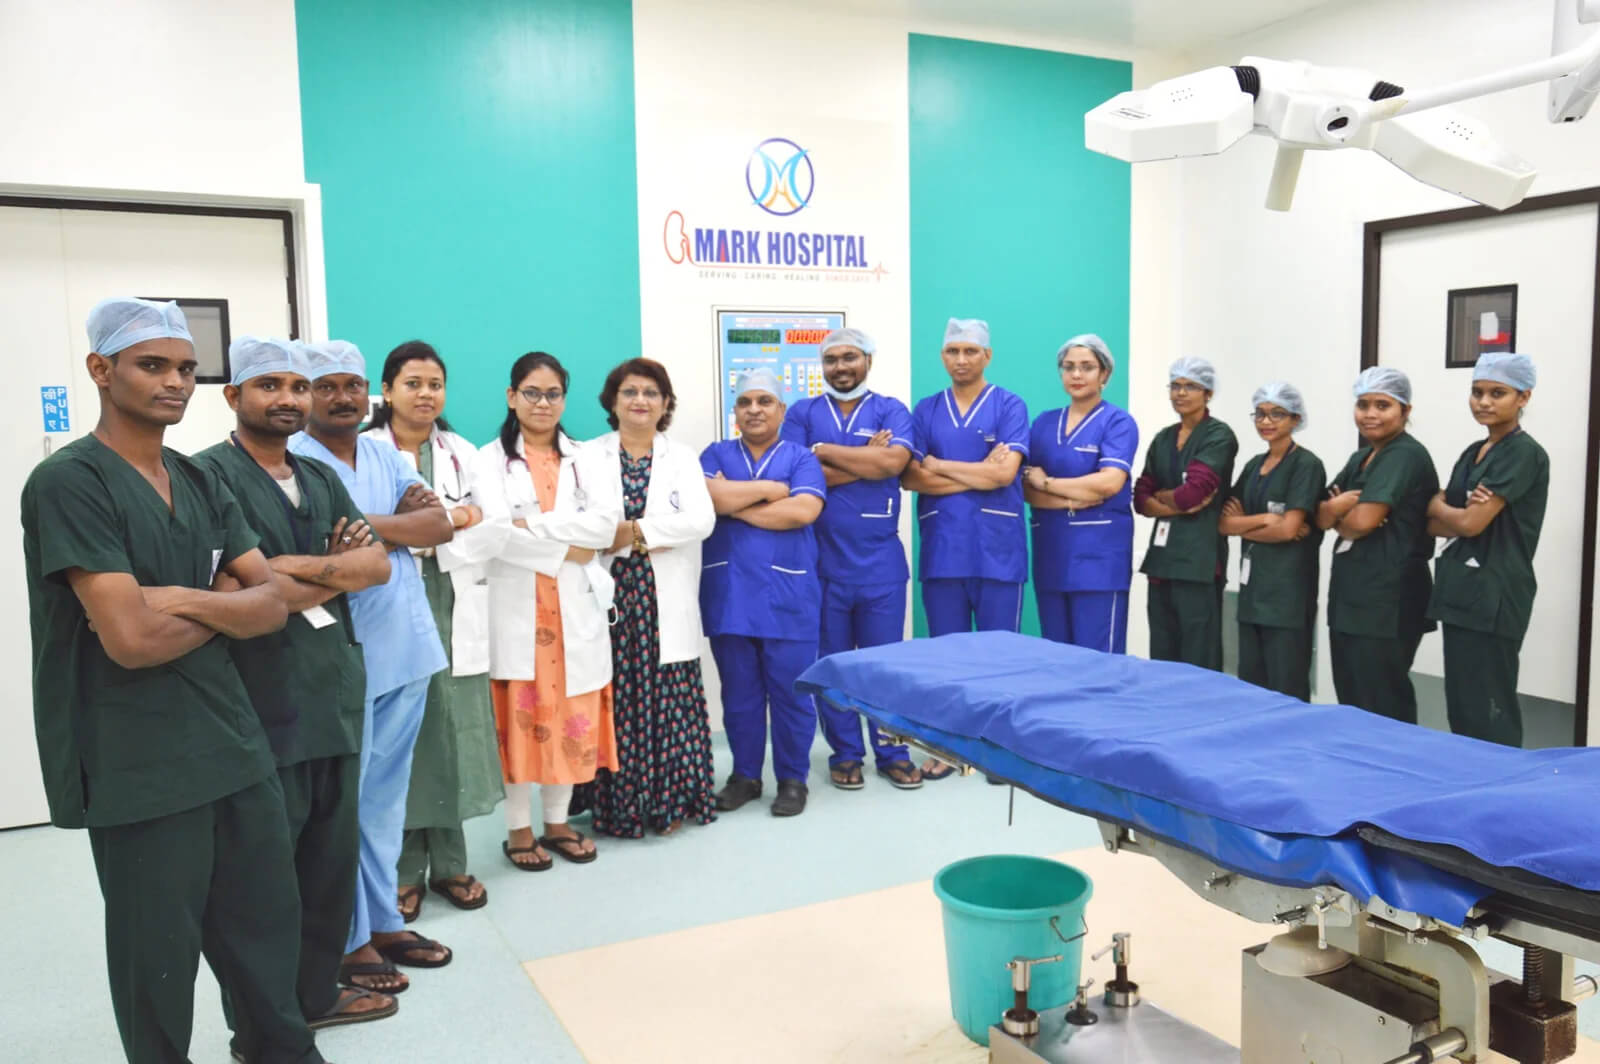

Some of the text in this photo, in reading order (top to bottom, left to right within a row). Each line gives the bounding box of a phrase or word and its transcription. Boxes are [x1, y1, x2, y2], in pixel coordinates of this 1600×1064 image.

[694, 227, 868, 267] MARK HOSPITAL
[57, 387, 69, 430] PULL
